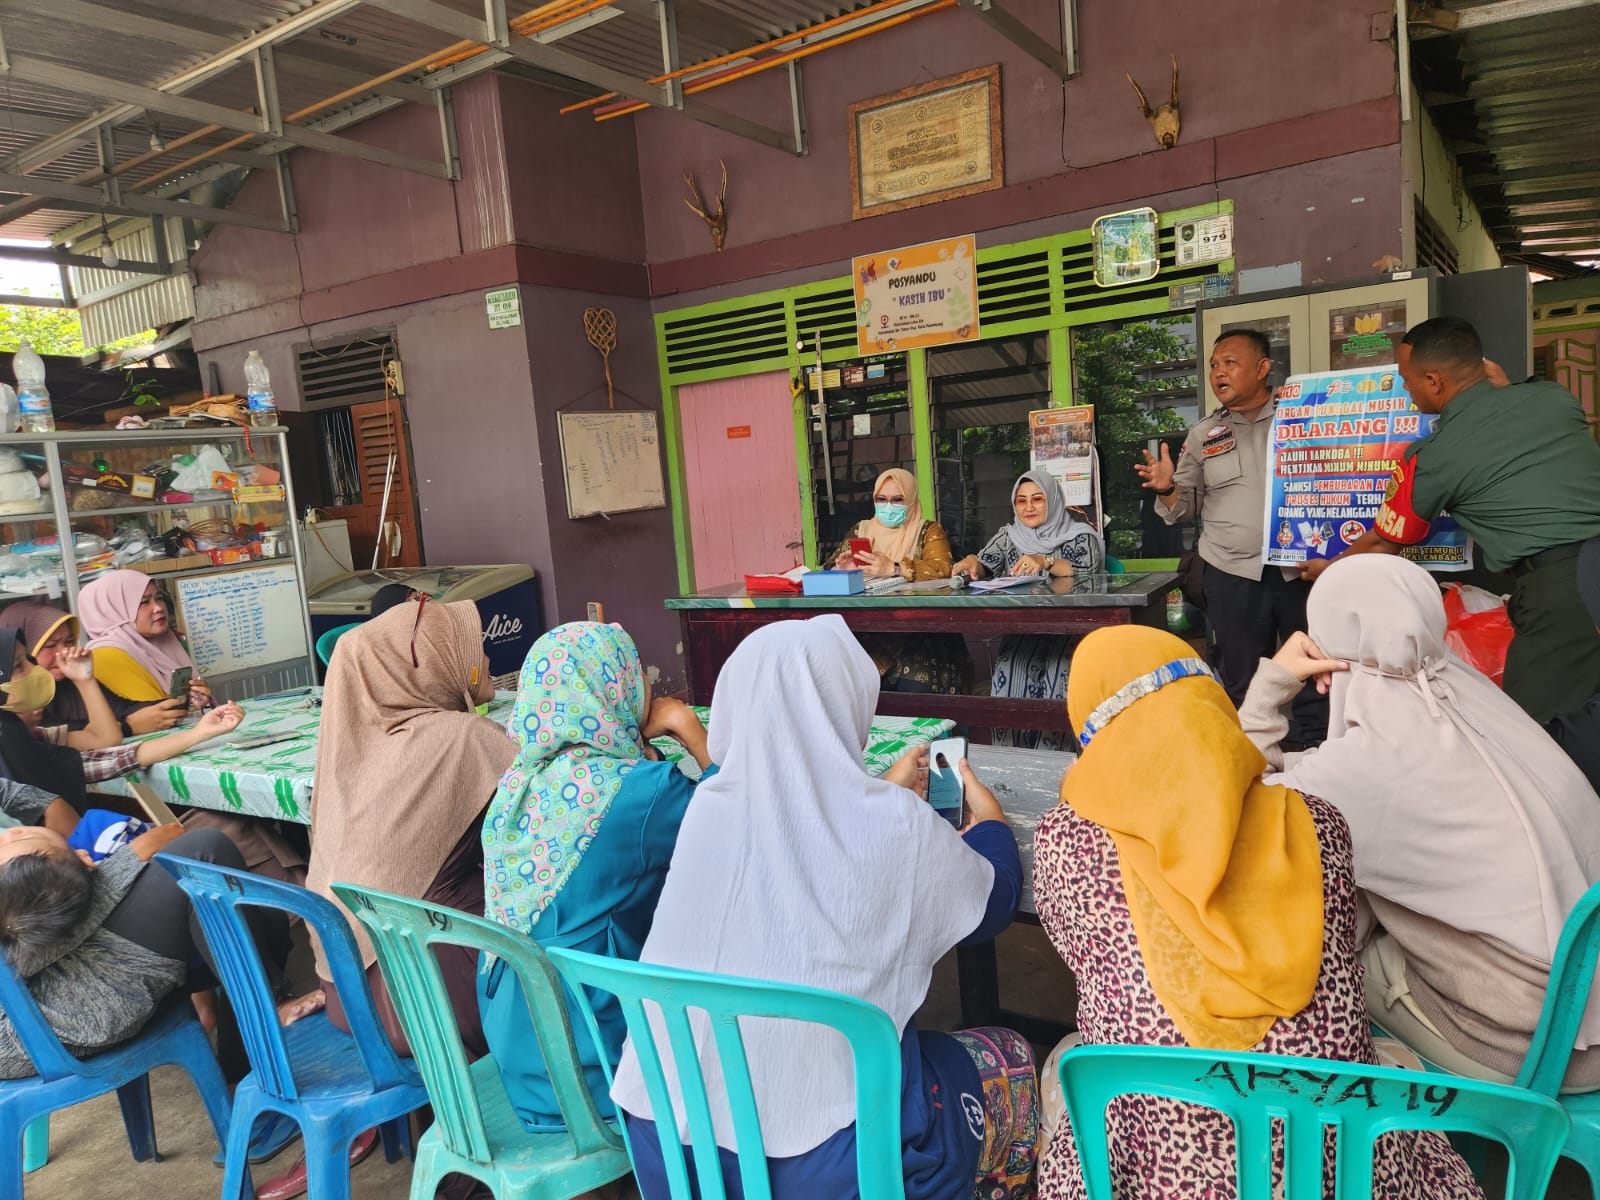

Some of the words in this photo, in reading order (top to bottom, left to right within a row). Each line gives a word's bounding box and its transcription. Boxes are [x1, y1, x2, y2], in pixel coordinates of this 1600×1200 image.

[1203, 232, 1227, 243] 979
[889, 271, 937, 289] POSYANDU
[898, 291, 927, 308] KASIH
[928, 289, 946, 302] IBU
[1368, 397, 1407, 412] MUSIK
[1277, 417, 1388, 441] DILARANG
[1393, 415, 1418, 433] !!!
[1280, 449, 1308, 462] JAUHI
[1323, 461, 1355, 473] MINUM
[1356, 459, 1398, 472] MINUMA
[1283, 481, 1312, 492] SANKSI
[1313, 479, 1374, 492] PEMBUBARAN
[1285, 493, 1319, 507] PROSES
[1319, 493, 1351, 506] HUKUM
[1278, 507, 1305, 518] ORANG
[1306, 506, 1326, 518] YANG
[1423, 546, 1454, 554] TIMUR
[482, 613, 523, 642] Aice
[424, 908, 449, 931] 19
[1401, 1080, 1459, 1117] 19
